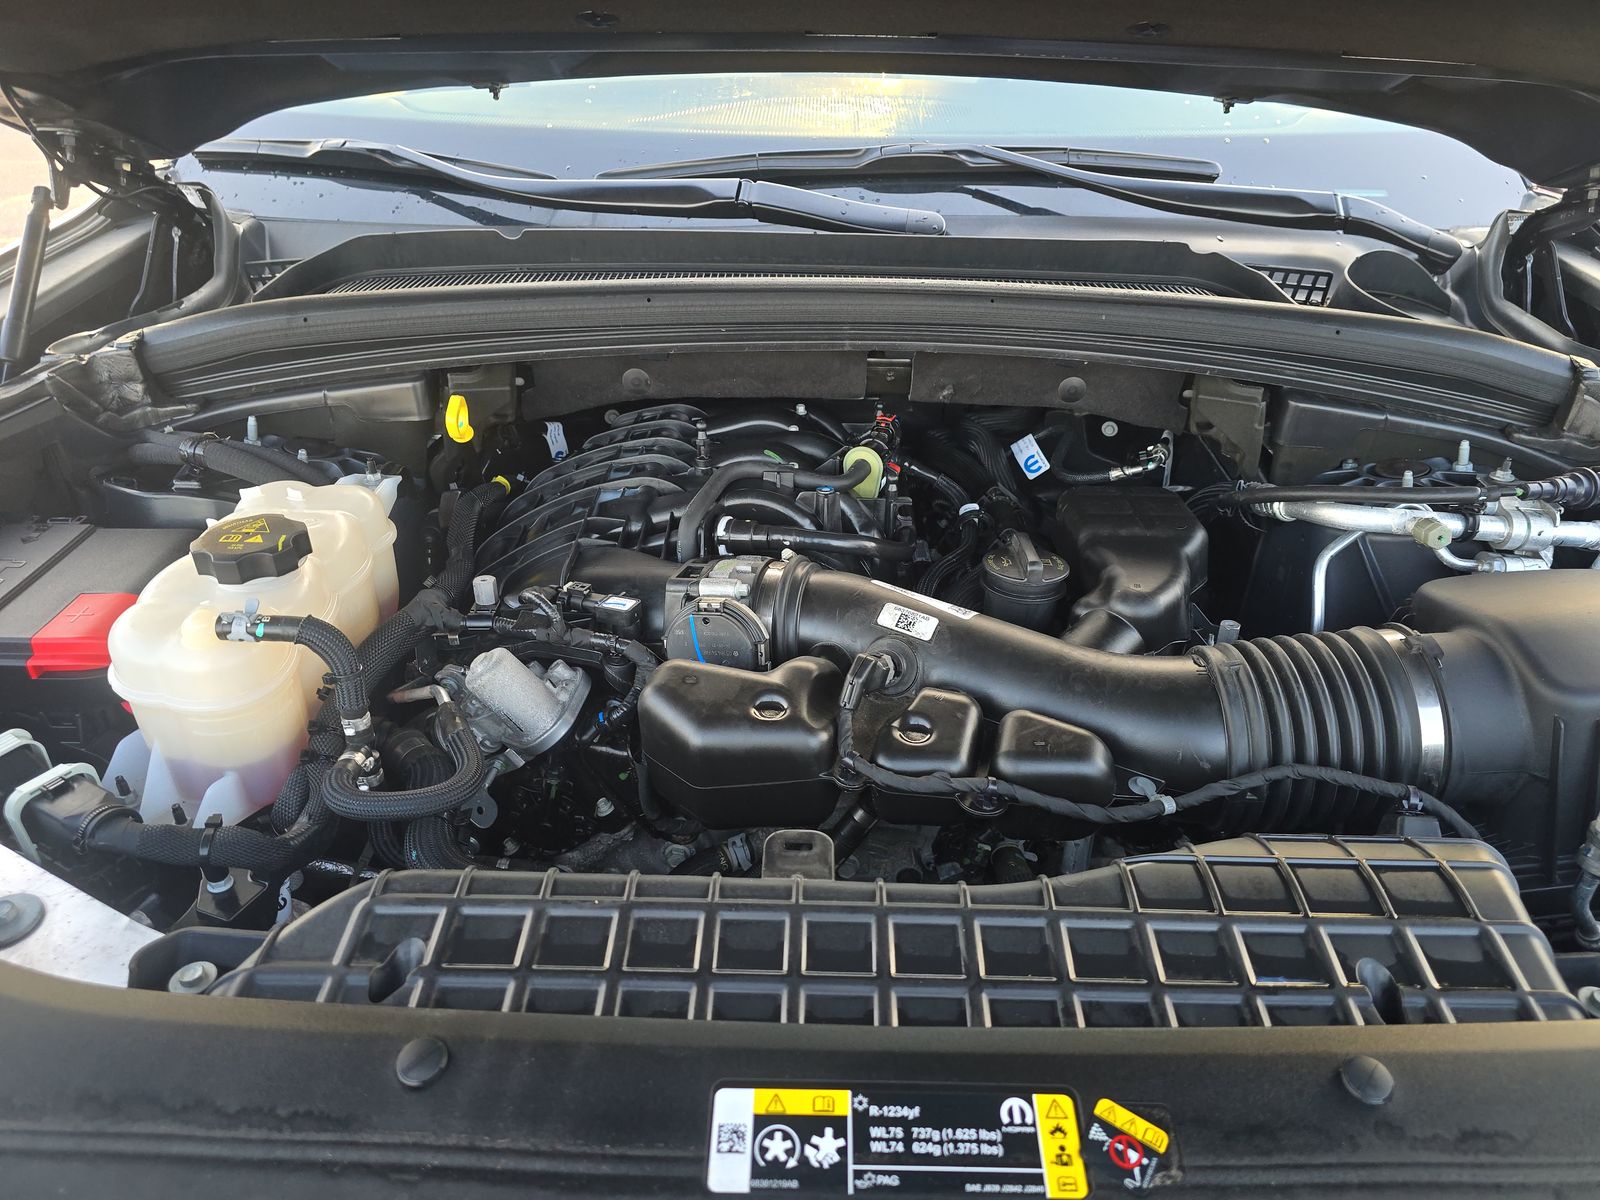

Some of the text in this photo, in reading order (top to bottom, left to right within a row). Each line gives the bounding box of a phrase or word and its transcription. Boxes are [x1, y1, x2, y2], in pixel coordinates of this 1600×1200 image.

[869, 1105, 921, 1120] R-1234yf
[869, 1126, 1002, 1143] WL75 737g (1.625 lbs)
[869, 1140, 1004, 1158] WL74 624g (1.375 lbs)
[876, 1175, 900, 1187] PAG
